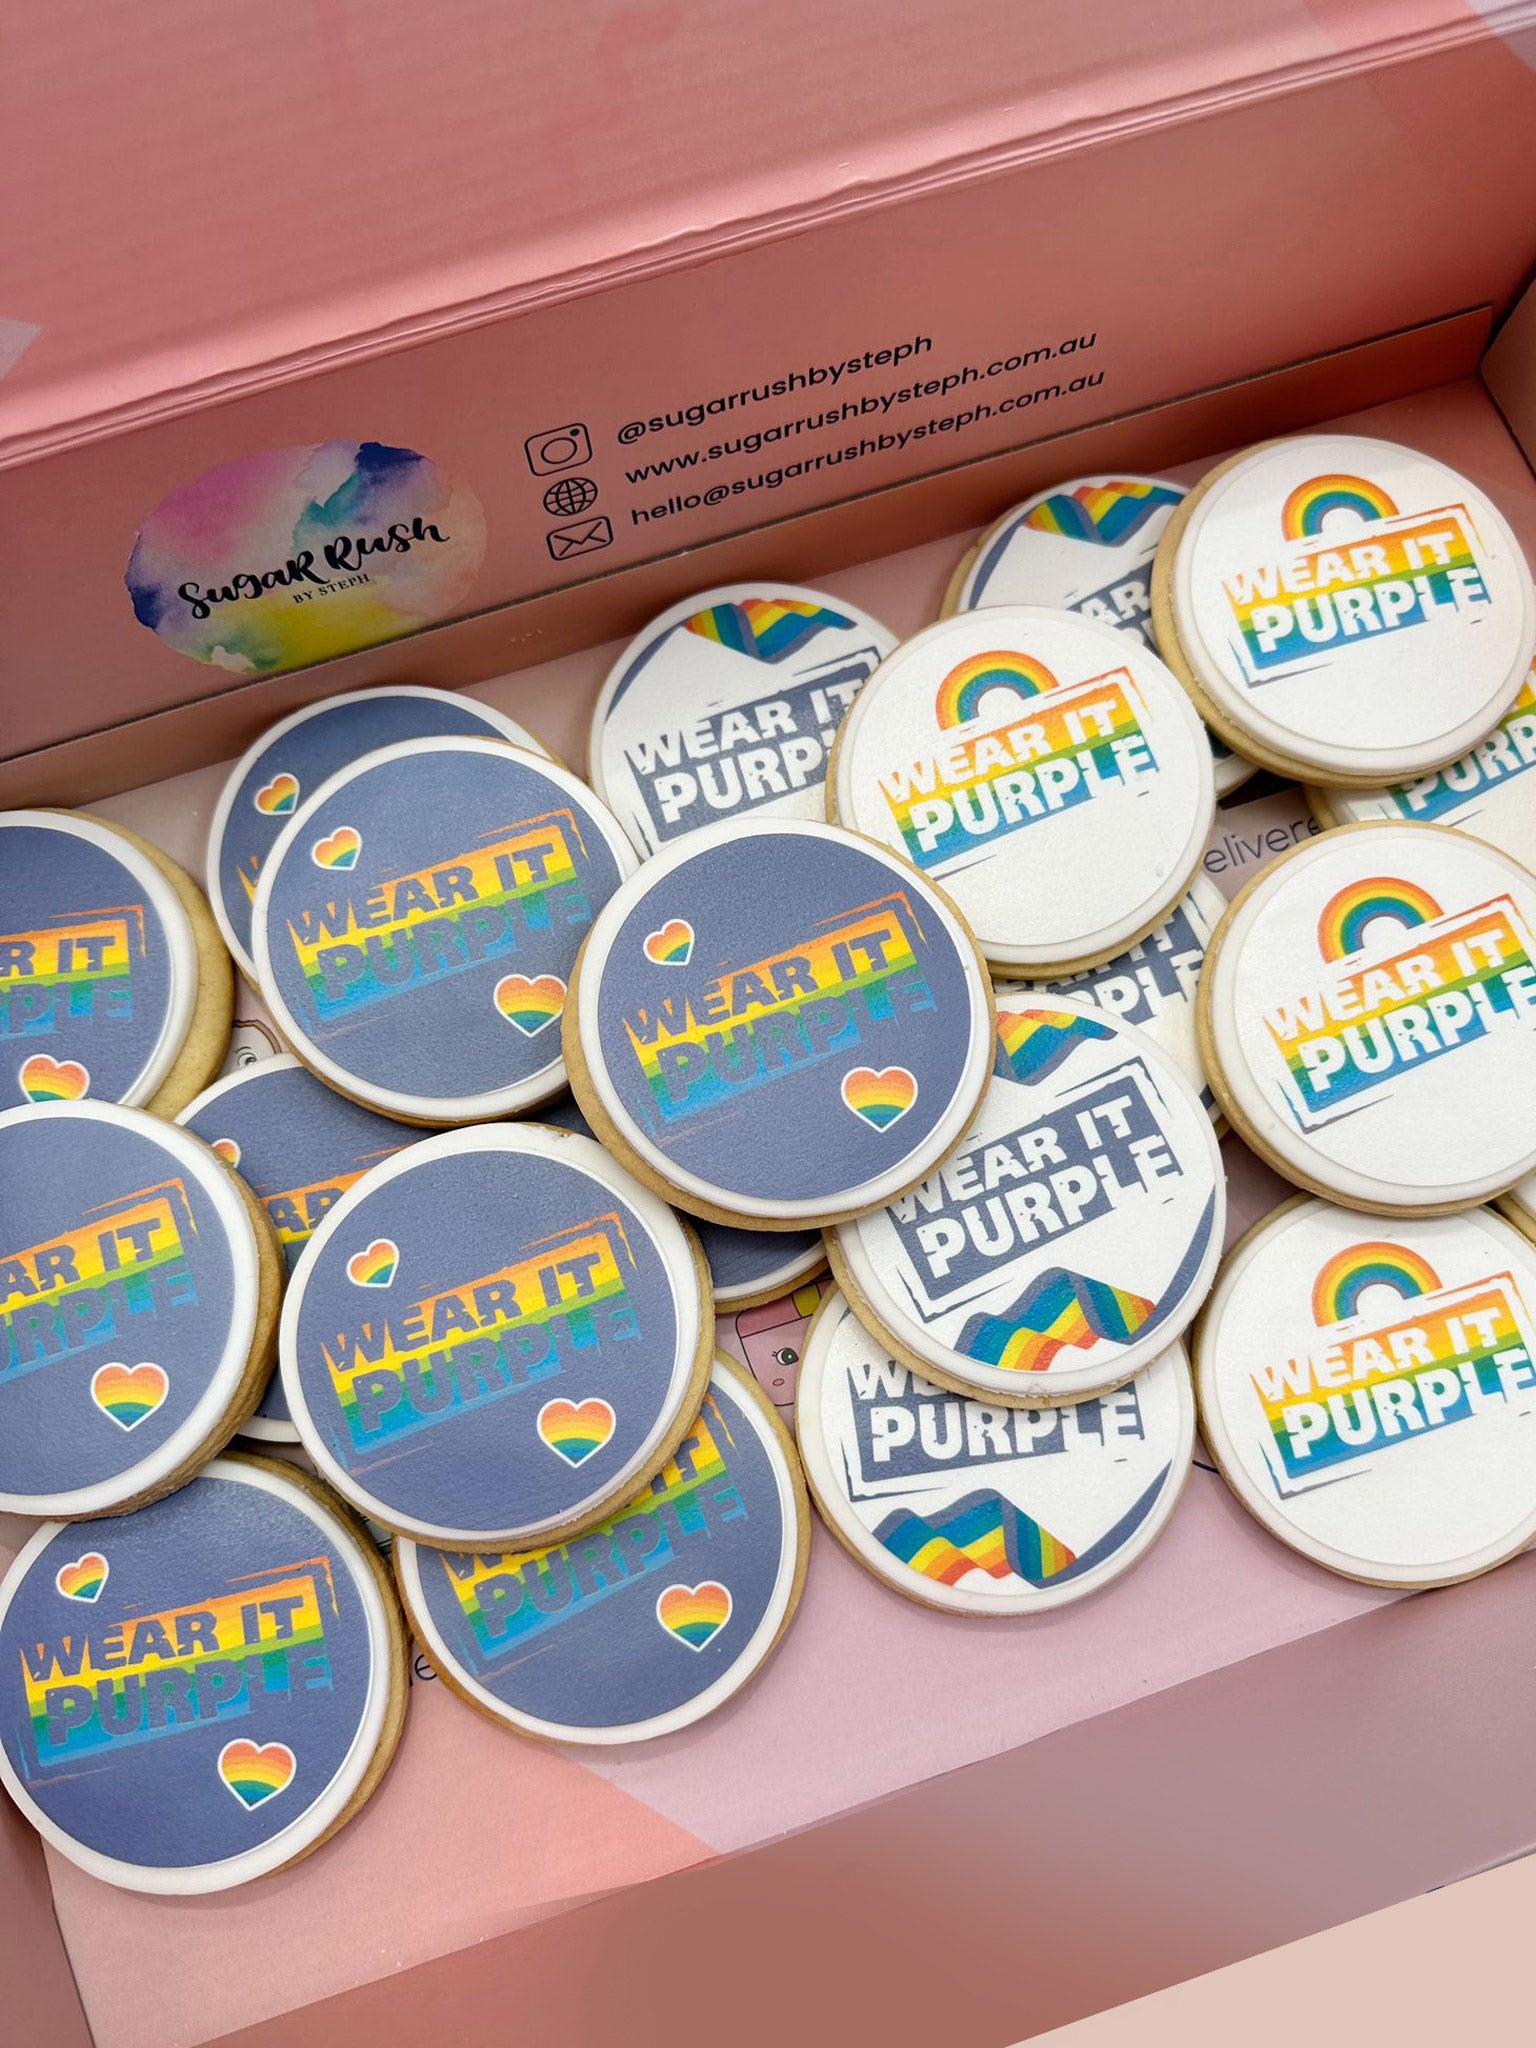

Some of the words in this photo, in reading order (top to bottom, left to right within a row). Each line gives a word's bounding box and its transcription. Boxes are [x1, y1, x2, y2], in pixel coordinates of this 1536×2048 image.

[617, 335, 933, 446] @sugarrushbysteph
[625, 332, 1097, 485] www.sugarrushbysteph.com.au
[631, 370, 1106, 525] hello@sugarrushbysteph.com.au
[293, 589, 314, 604] BY
[320, 573, 371, 596] STEPH
[1080, 581, 1151, 624] AR
[1223, 544, 1392, 605] WEAR
[1401, 531, 1455, 569] IT
[1250, 567, 1487, 654] PURPLE
[626, 700, 798, 775] WEAR
[654, 730, 836, 824] PURP
[878, 723, 1053, 803] WEAR
[1062, 699, 1118, 746] IT
[1400, 713, 1536, 813] PURP
[909, 735, 1153, 853] PURPLE
[288, 866, 478, 945] WEAR
[495, 843, 554, 892] IT
[317, 884, 588, 1000] PURPLE
[8, 977, 131, 1034] PLE
[57, 936, 116, 973] IT
[625, 956, 819, 1045] WEAR
[831, 929, 892, 981] IT
[1263, 953, 1445, 1042] WEAR
[1451, 927, 1507, 977] IT
[656, 967, 934, 1103] PURPLE
[1297, 964, 1536, 1093] PURPLE
[887, 1126, 1067, 1225] WEAR
[1075, 1095, 1133, 1150] IT
[916, 1134, 1176, 1279] PURPLE
[0, 1244, 82, 1297] AR
[98, 1217, 161, 1272] IT
[2, 1258, 194, 1366] RPLE
[322, 1279, 522, 1372] WEAR
[538, 1252, 601, 1308] IT
[352, 1295, 637, 1434] PURPLE
[1250, 1326, 1435, 1403] WEAR
[1444, 1306, 1500, 1356] IT
[870, 1391, 1139, 1463] PURPLE
[1281, 1347, 1534, 1459] PURPLE
[473, 1474, 746, 1639] PURPLE
[21, 1610, 220, 1681] WEAR
[240, 1595, 304, 1645] IT
[45, 1641, 332, 1746] PURPLE
